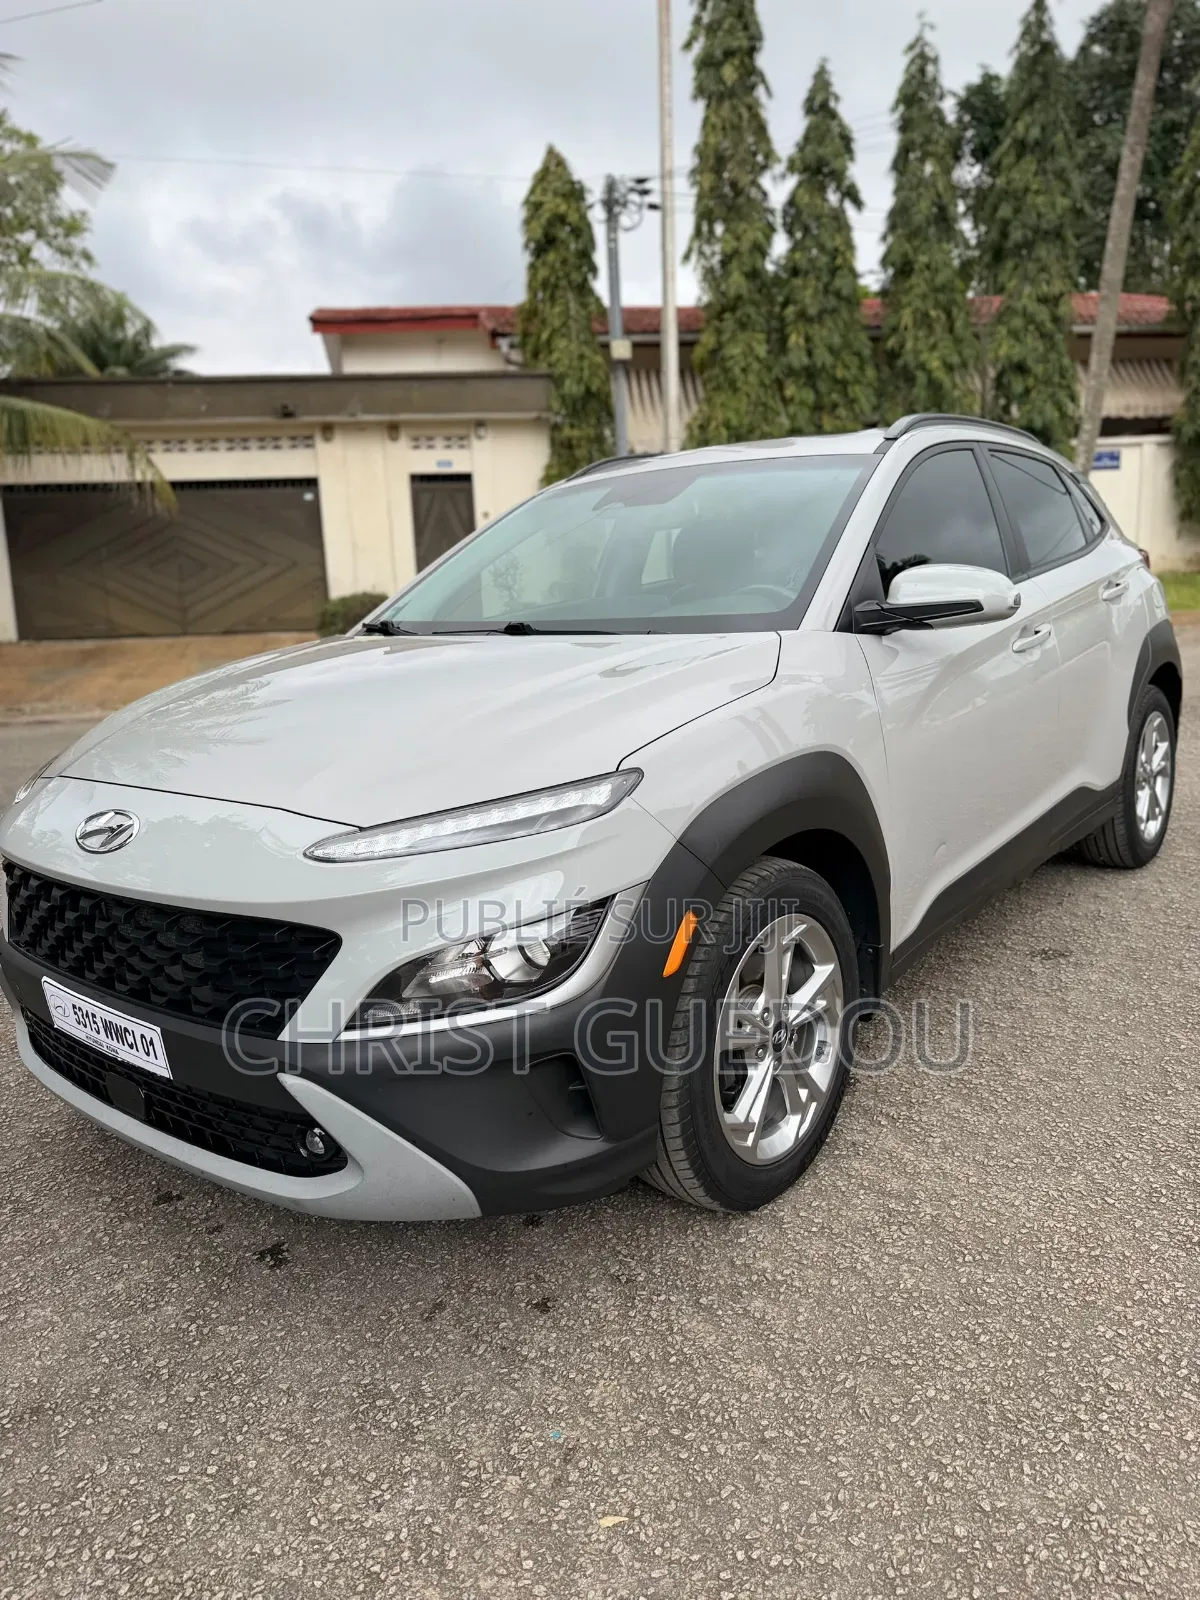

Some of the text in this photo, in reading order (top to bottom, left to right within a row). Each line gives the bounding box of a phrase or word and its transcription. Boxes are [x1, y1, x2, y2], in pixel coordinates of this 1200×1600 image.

[72, 1004, 158, 1060] 5315 WWCI 01
